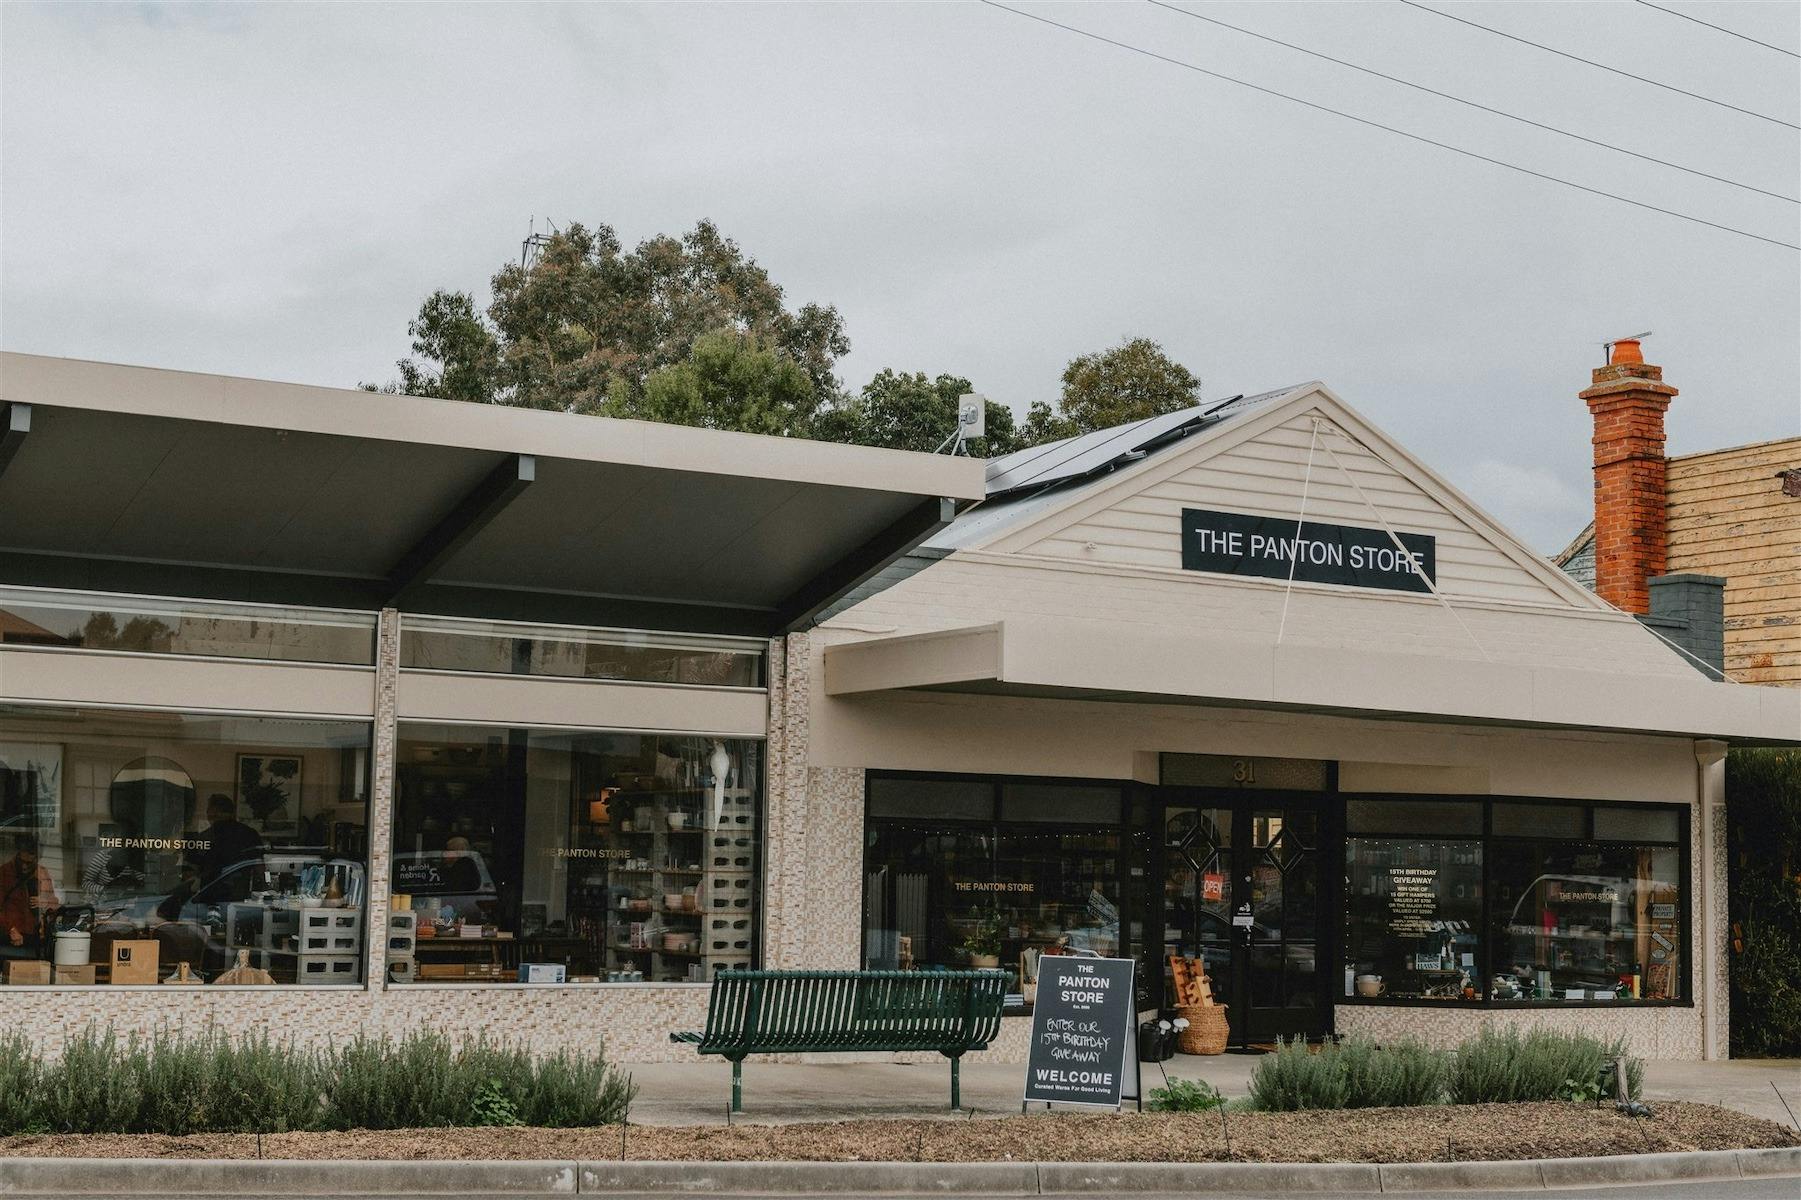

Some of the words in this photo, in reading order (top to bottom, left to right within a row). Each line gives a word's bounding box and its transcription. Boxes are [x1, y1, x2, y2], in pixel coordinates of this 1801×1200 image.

[1195, 528, 1243, 556] THE
[1250, 534, 1343, 567] PANTON
[1349, 545, 1424, 575] STORE
[1233, 760, 1256, 784] 31
[100, 838, 122, 848] THE
[125, 838, 170, 849] PANTON
[173, 840, 212, 850] STORE
[558, 848, 596, 858] PANTON
[598, 849, 631, 858] STORE
[954, 882, 971, 891] THE
[973, 882, 1006, 891] PANTON
[1007, 883, 1034, 892] STORE
[1203, 880, 1223, 894] OPEN
[1572, 892, 1597, 900] PANTON
[1598, 892, 1619, 900] STORE
[1077, 964, 1094, 973] THE
[1058, 976, 1110, 989] PANTON
[1061, 990, 1104, 1004] STORE
[1046, 1018, 1076, 1031] ENTER
[1078, 1021, 1101, 1033] OUR
[1062, 1032, 1111, 1052] BIRTHDAY
[1036, 1069, 1113, 1085] WELCOME
